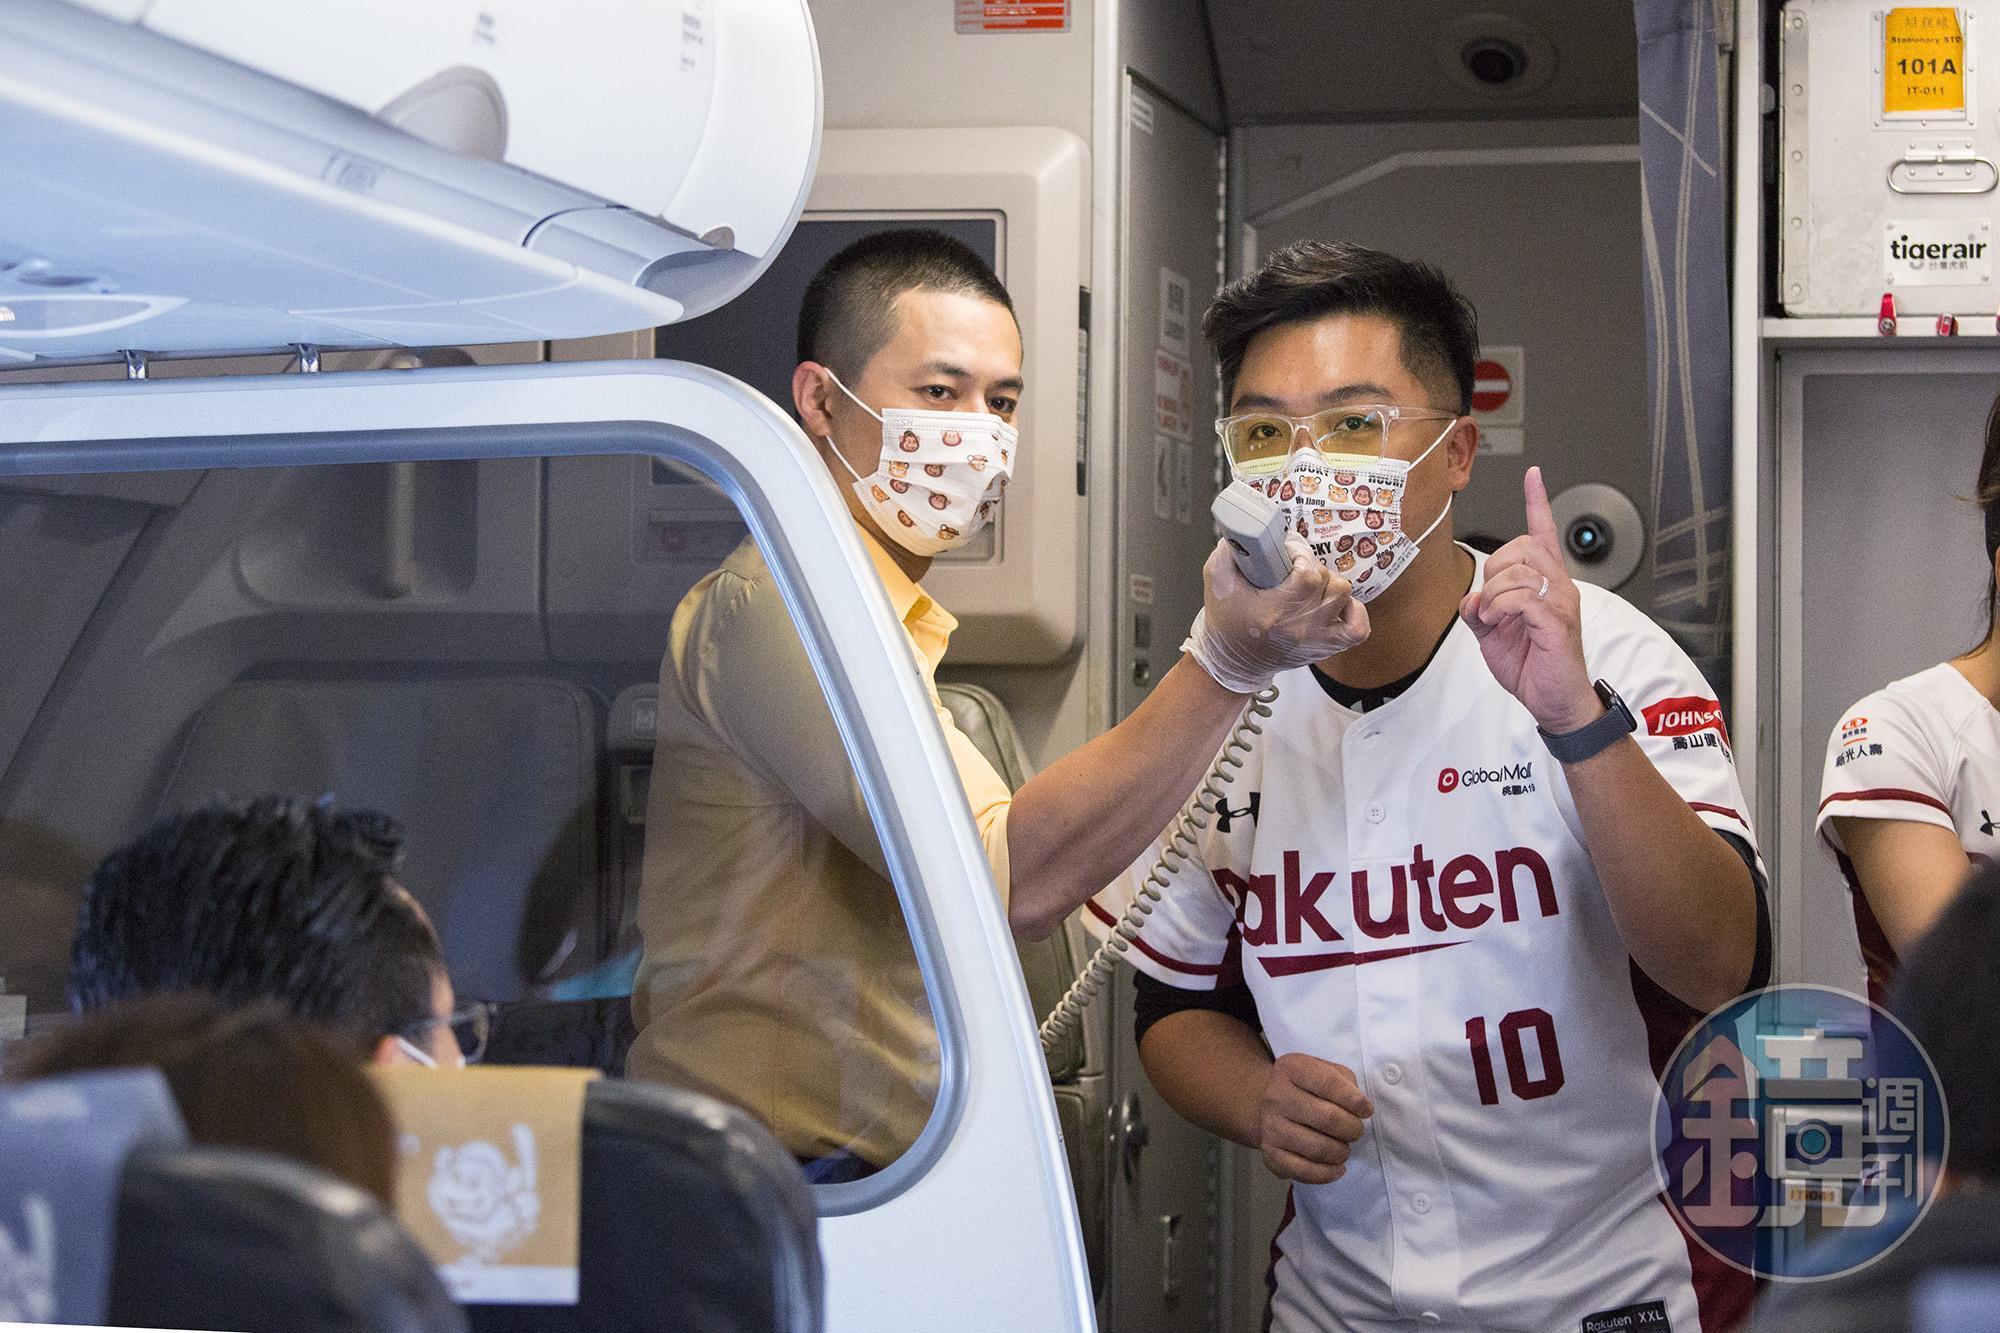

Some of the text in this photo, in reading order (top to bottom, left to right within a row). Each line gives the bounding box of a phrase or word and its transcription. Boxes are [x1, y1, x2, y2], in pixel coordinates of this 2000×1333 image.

[1897, 58, 1957, 75] 101A
[1890, 234, 1987, 270] tigerair
[1314, 524, 1343, 535] Rakuten
[1834, 743, 1883, 768] 新光人壽
[1465, 1007, 1565, 1105] 10
[1586, 1309, 1664, 1333] Rakuten XXL
